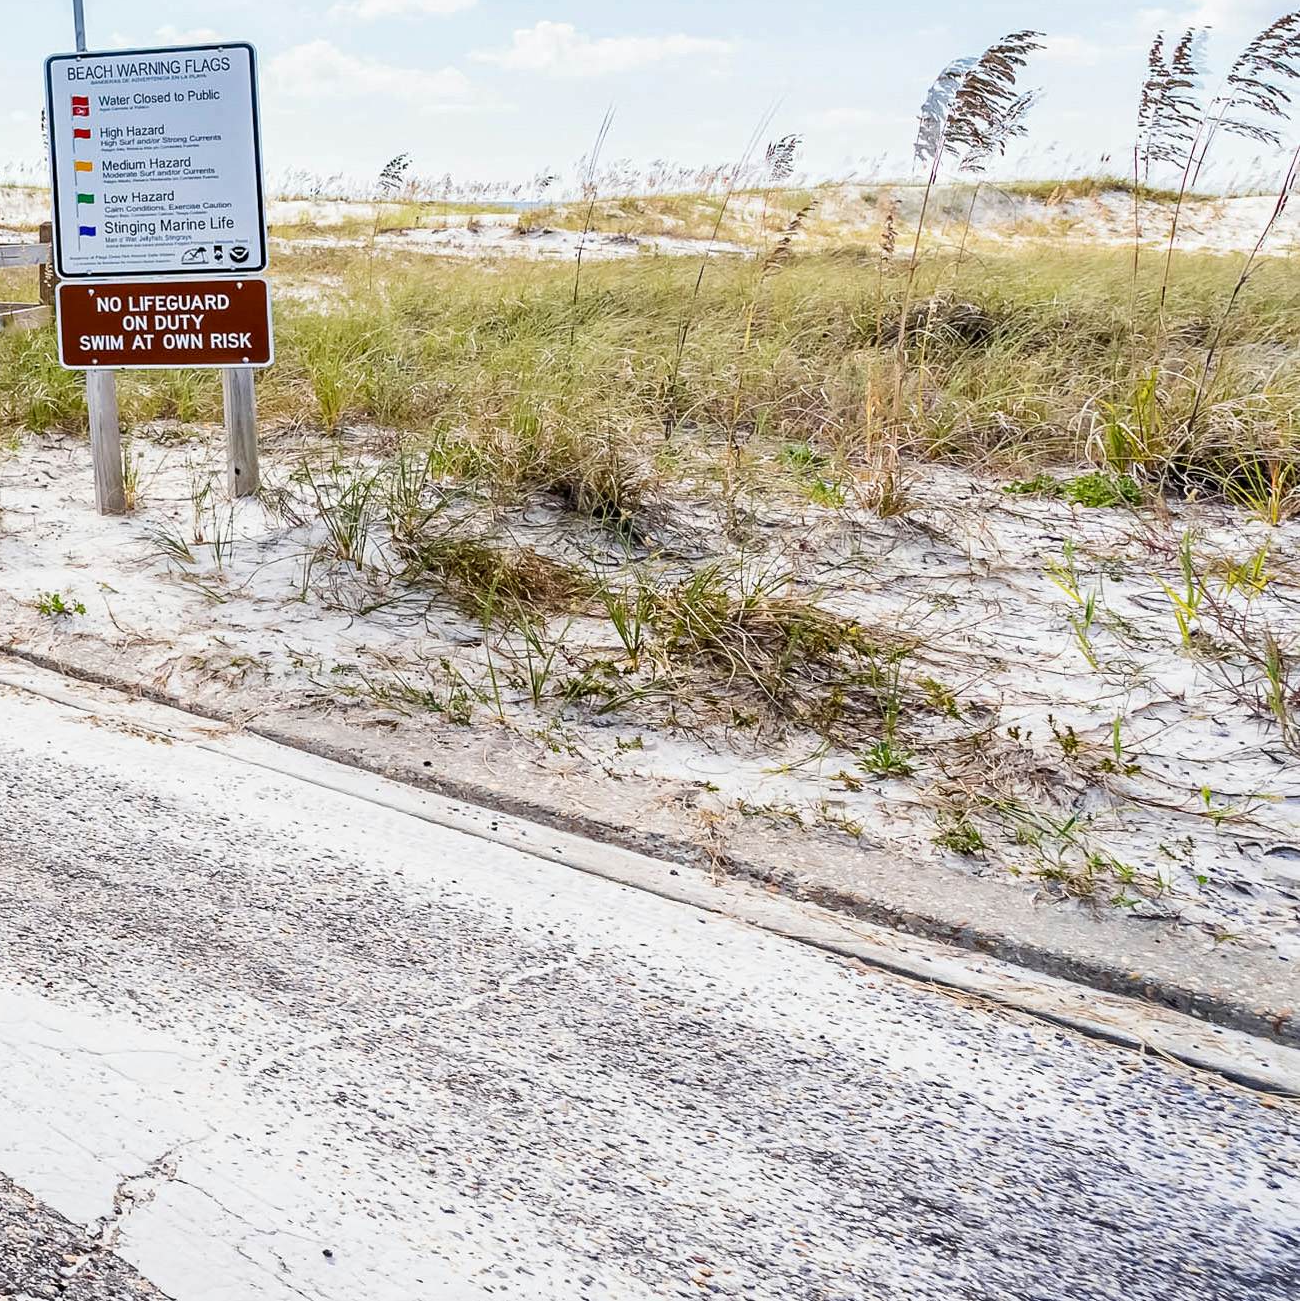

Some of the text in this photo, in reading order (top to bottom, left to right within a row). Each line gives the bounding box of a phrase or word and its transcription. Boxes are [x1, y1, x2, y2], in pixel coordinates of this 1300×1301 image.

[67, 57, 231, 81] BEACH WARNING FLAGS
[99, 89, 220, 107] Water Closed to Public
[100, 124, 165, 140] High Hazard
[100, 140, 117, 148] High
[119, 137, 135, 146] Surf
[162, 136, 187, 144] Strong
[189, 134, 222, 142] Currents
[102, 156, 191, 171] Medium Hazard
[102, 171, 138, 179] Moderate
[139, 170, 155, 178] Surf
[182, 167, 216, 175] Currents
[104, 190, 175, 204] Low Hazard
[168, 203, 200, 211] Exercise
[202, 201, 232, 209] Caution
[104, 216, 234, 236] Stinging Marine Life
[97, 294, 230, 313] NO LIFEGUARD
[122, 314, 204, 331] ON DUTY
[79, 332, 252, 351] SWIM AT OWN RISK
